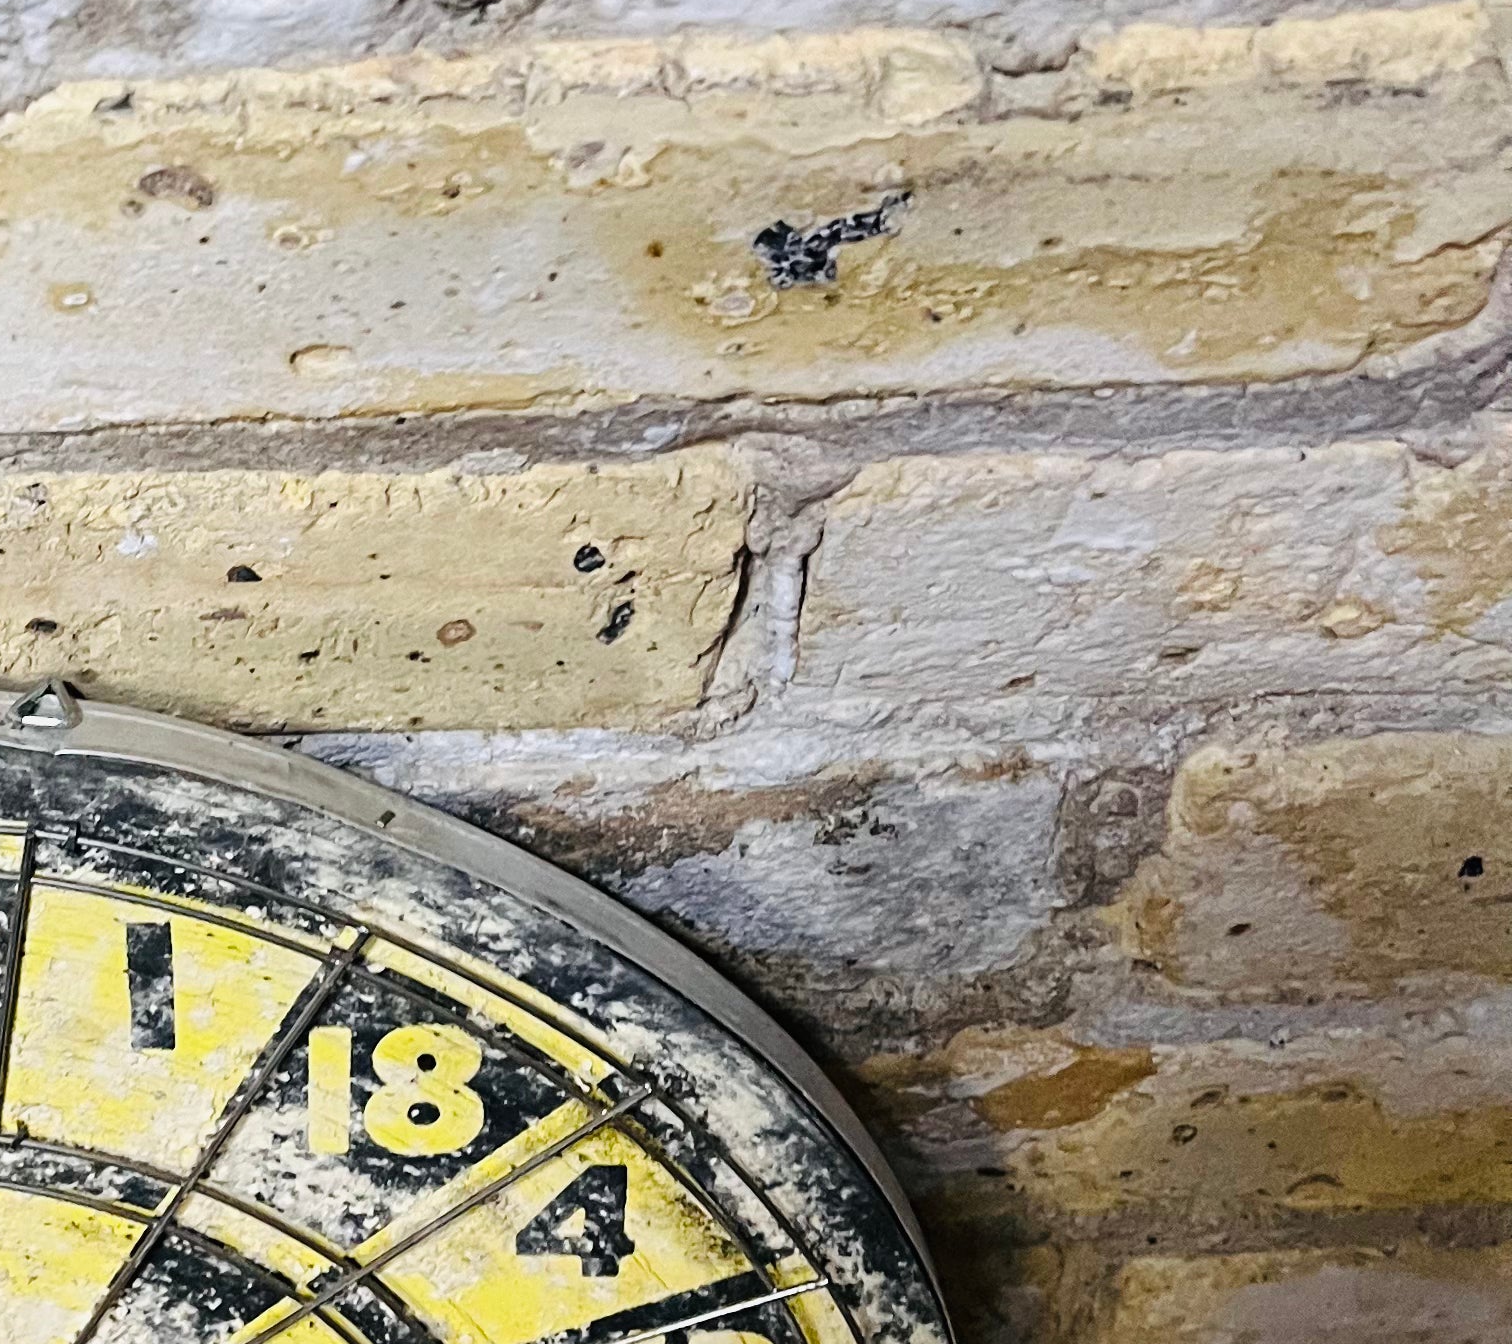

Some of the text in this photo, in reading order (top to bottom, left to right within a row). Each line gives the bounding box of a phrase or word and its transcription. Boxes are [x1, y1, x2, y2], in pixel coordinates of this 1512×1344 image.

[126, 922, 174, 1050] 1
[307, 1024, 484, 1156] 18
[515, 1164, 634, 1276] 4
